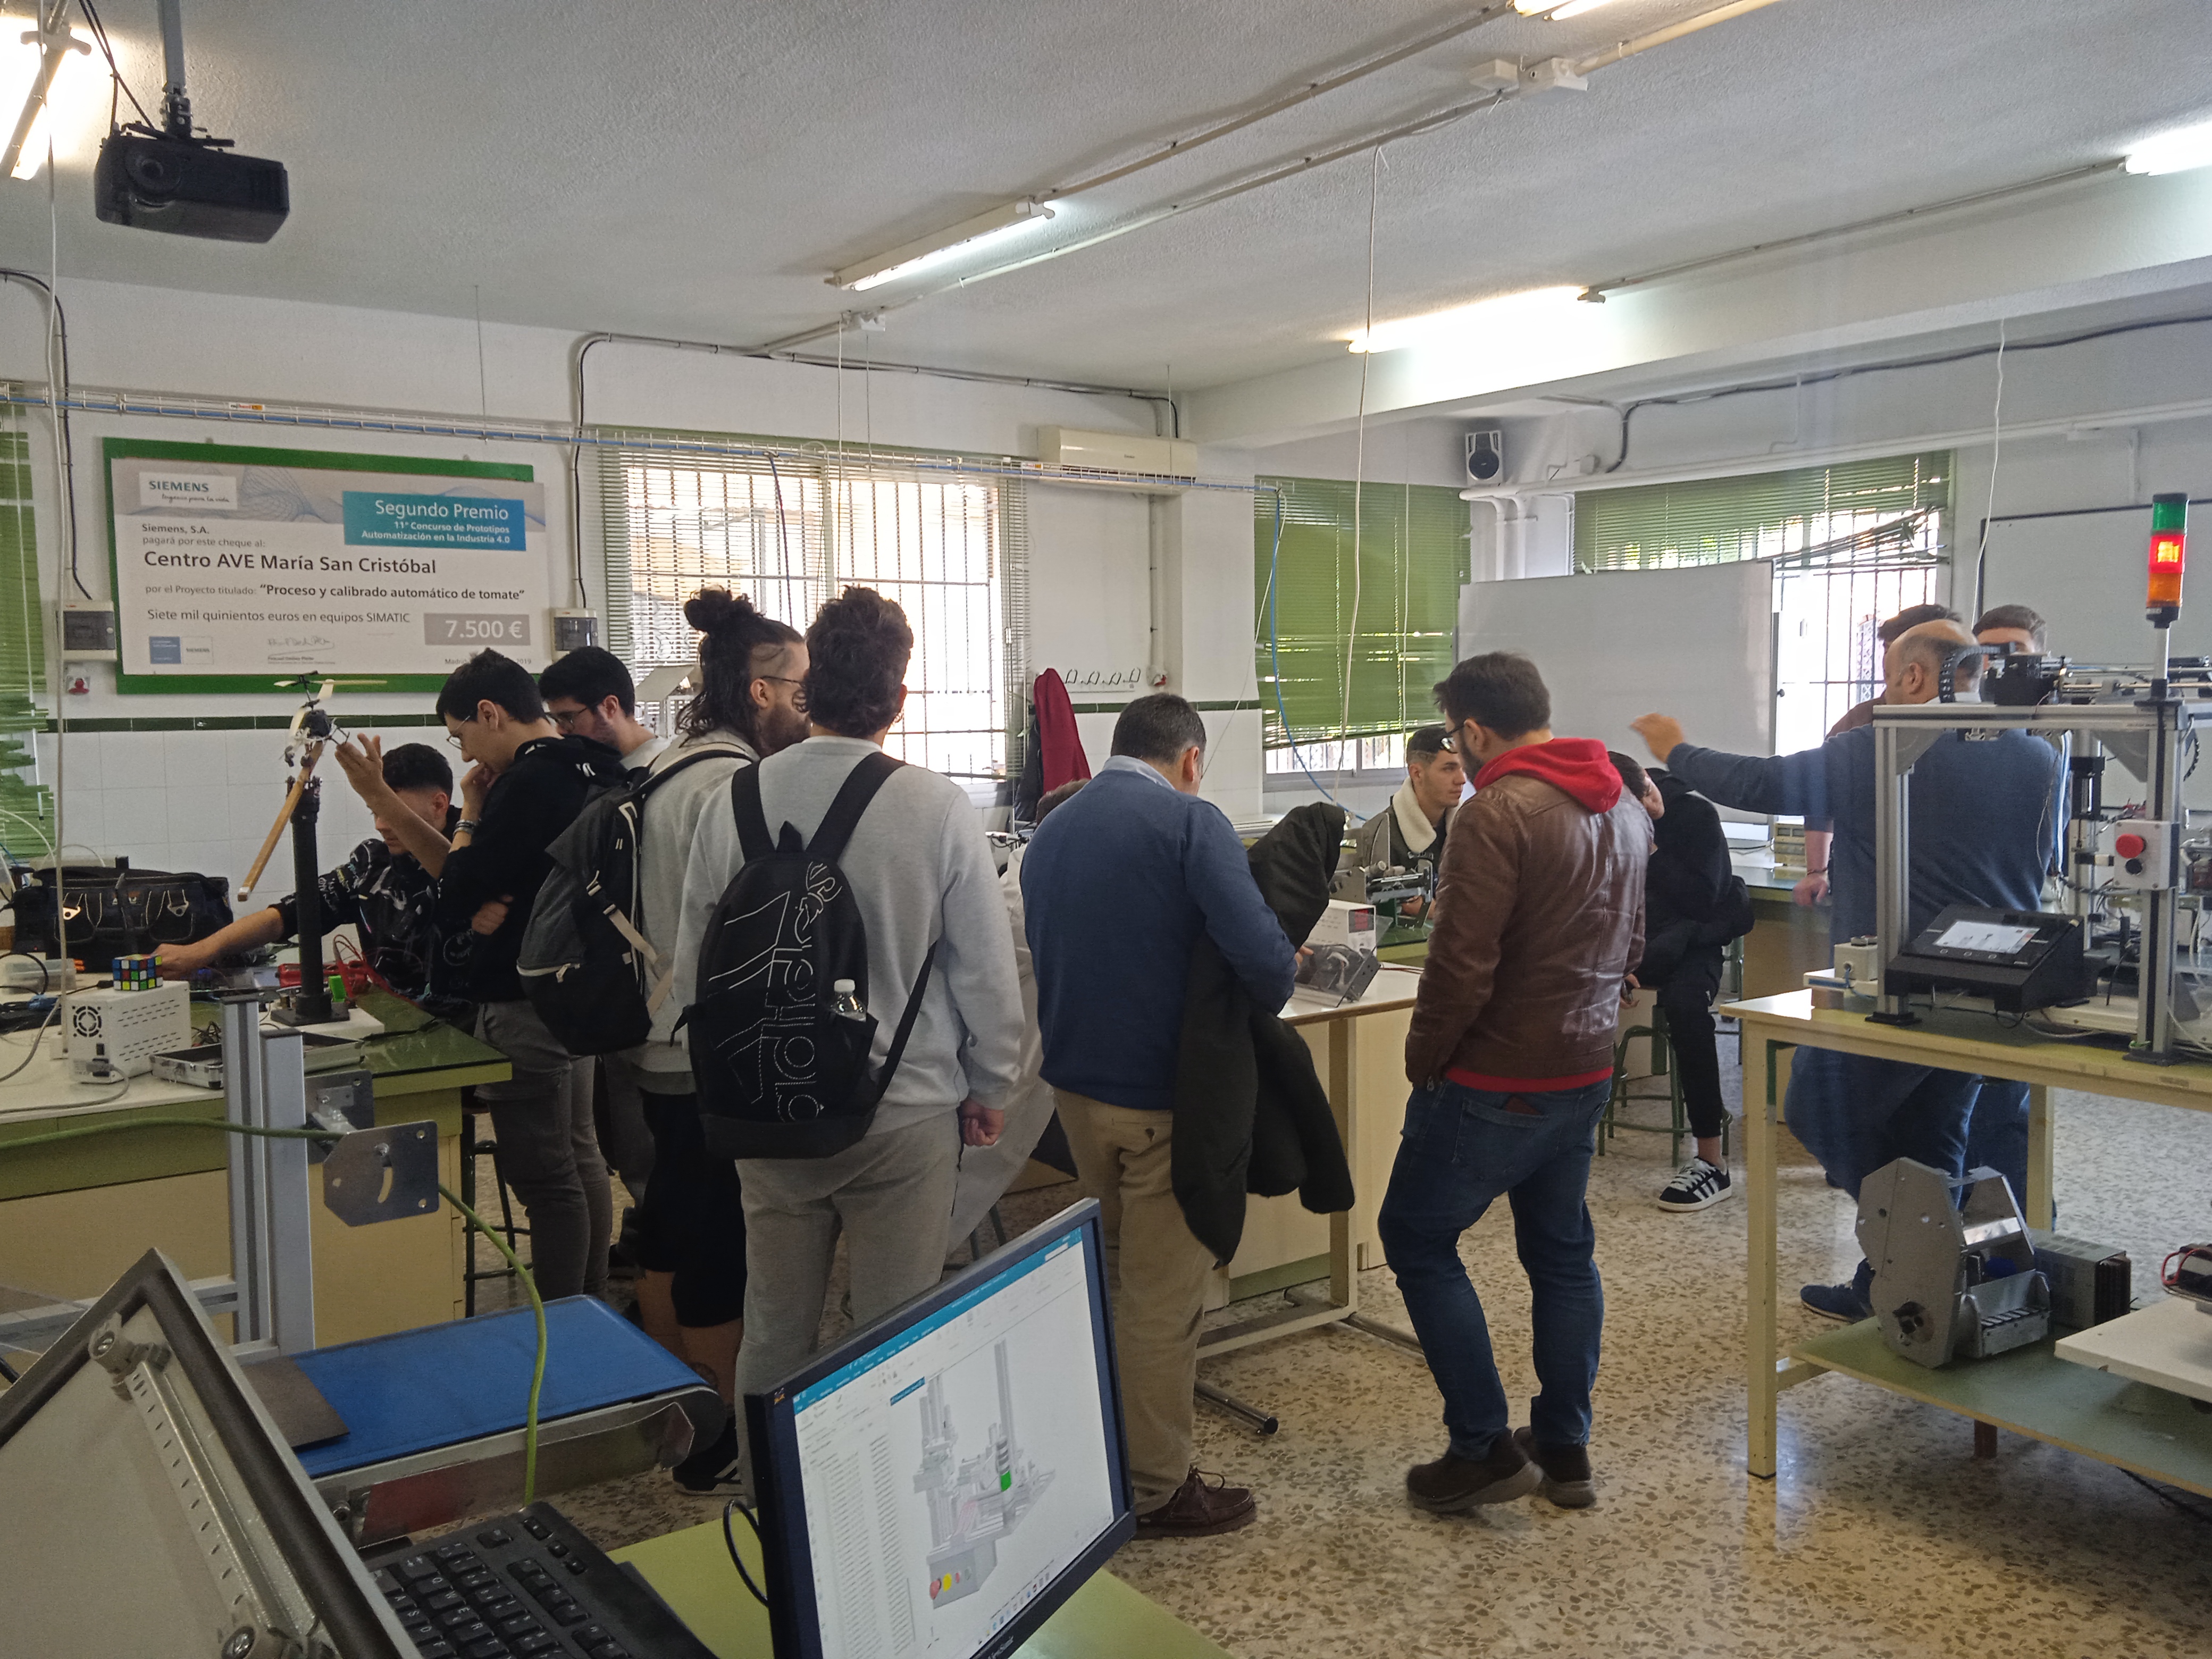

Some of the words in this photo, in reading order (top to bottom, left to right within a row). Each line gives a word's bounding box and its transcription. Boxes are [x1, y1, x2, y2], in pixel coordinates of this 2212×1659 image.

[148, 480, 210, 492] SIEMENS
[375, 500, 448, 519] Segundo
[454, 503, 509, 520] Premio
[142, 524, 188, 534] Siemens,
[190, 525, 210, 534] S.A.
[410, 522, 451, 531] Concurso
[453, 523, 464, 532] de
[466, 524, 509, 534] Prototipos
[143, 536, 175, 546] pagará
[218, 539, 252, 548] cheque
[254, 539, 266, 548] al:
[362, 530, 431, 541] Automatización
[496, 535, 510, 543] 4.0
[144, 551, 211, 567] Centro
[217, 554, 255, 568] AVE
[261, 555, 313, 570] María
[320, 557, 353, 572] San
[358, 557, 436, 574] Cristóbal
[145, 586, 161, 594] por
[175, 585, 215, 596] Proyecto
[319, 588, 326, 598] y
[330, 586, 387, 597] calibrado
[391, 588, 458, 598] automático
[461, 589, 476, 599] de
[147, 609, 178, 620] Siete
[181, 609, 199, 619] mil
[203, 610, 265, 622] quinientos
[267, 613, 300, 621] euros
[320, 612, 364, 624] equipos
[366, 613, 410, 623] SIMATIC
[445, 620, 504, 638] 7.500
[508, 621, 523, 639] €
